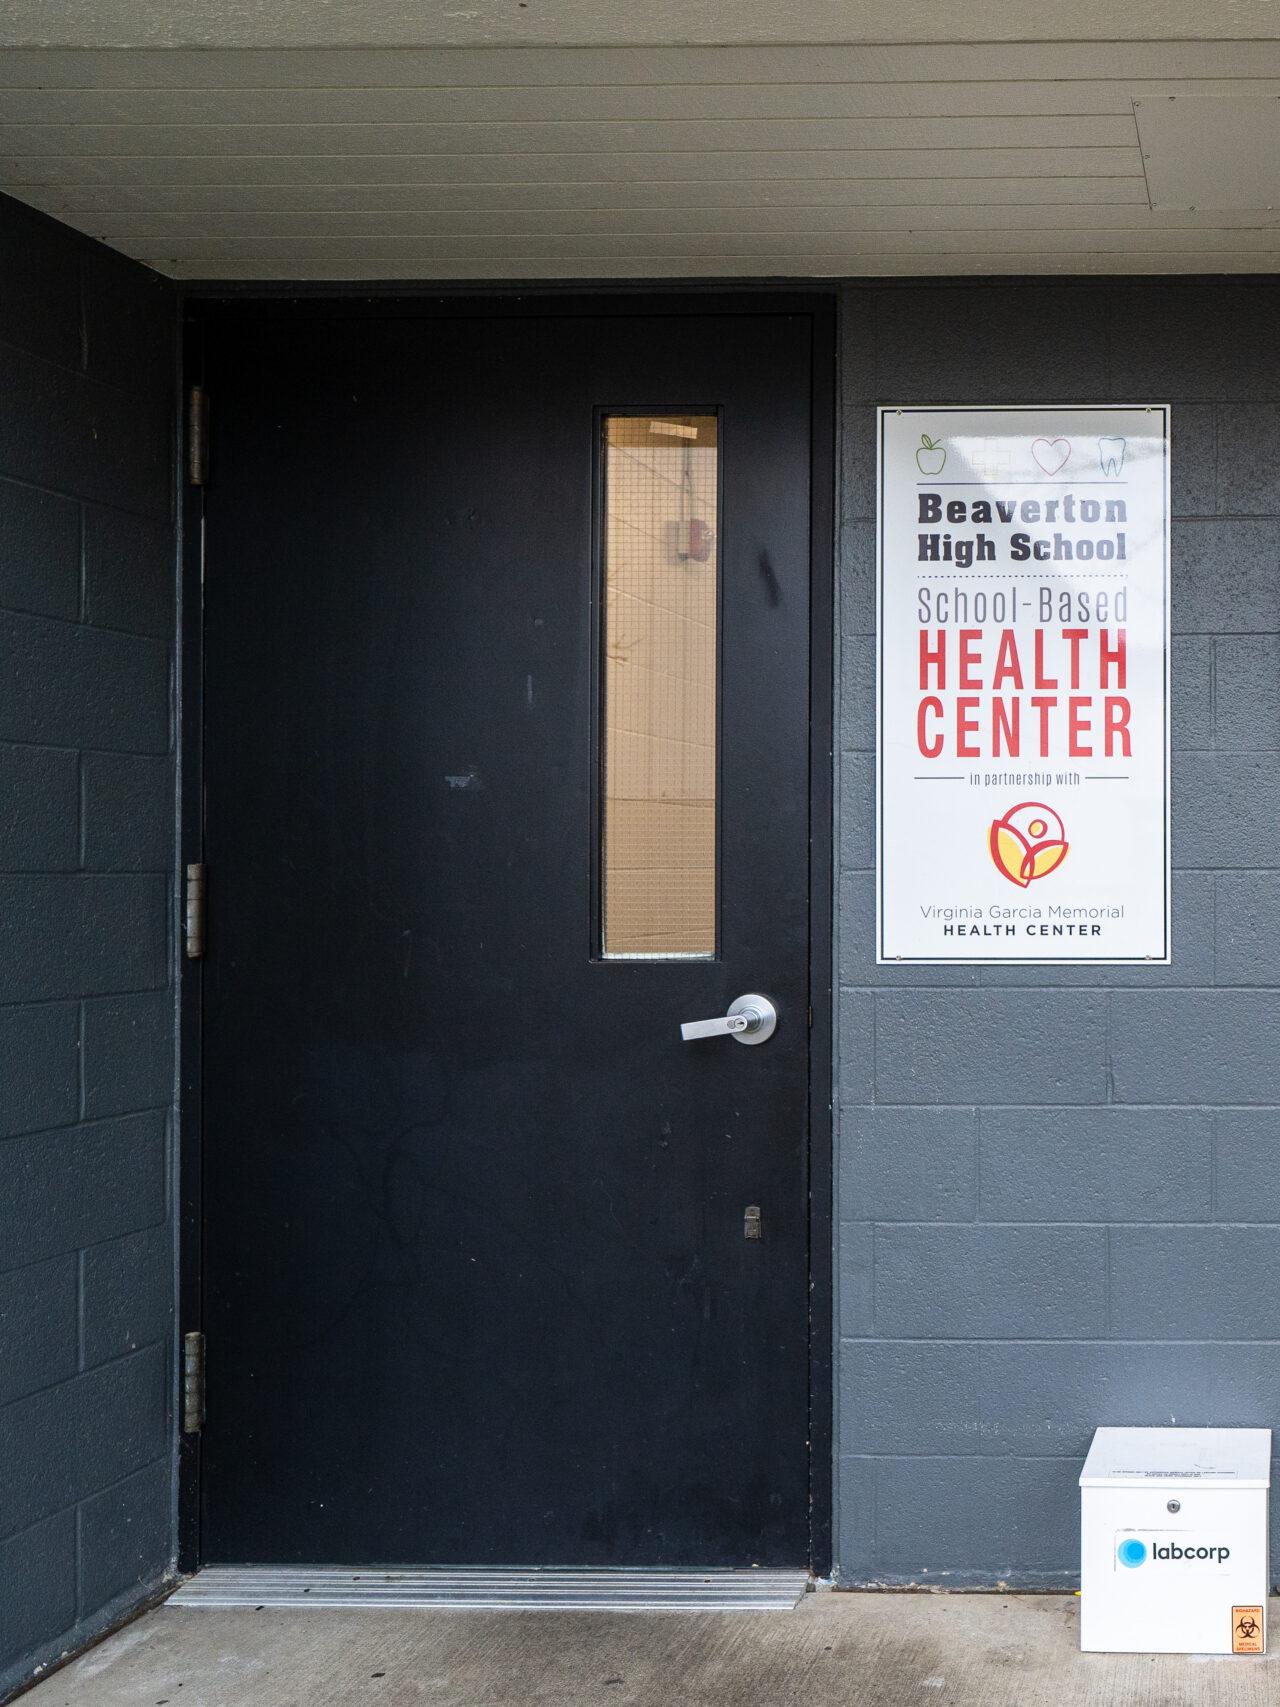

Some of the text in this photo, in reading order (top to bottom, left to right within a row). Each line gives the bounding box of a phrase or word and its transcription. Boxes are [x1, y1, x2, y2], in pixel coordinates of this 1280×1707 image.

[918, 493, 1127, 523] Beaverton
[918, 533, 1126, 568] High School
[918, 587, 1127, 623] School-Based
[919, 628, 1127, 690] HEALTH
[917, 696, 1132, 758] CENTER
[970, 772, 1080, 786] in partnership with
[920, 905, 1124, 920] Virginia Garcia Memorial
[944, 925, 1101, 936] HEALTH CENTER
[1153, 1542, 1230, 1564] labcorp
